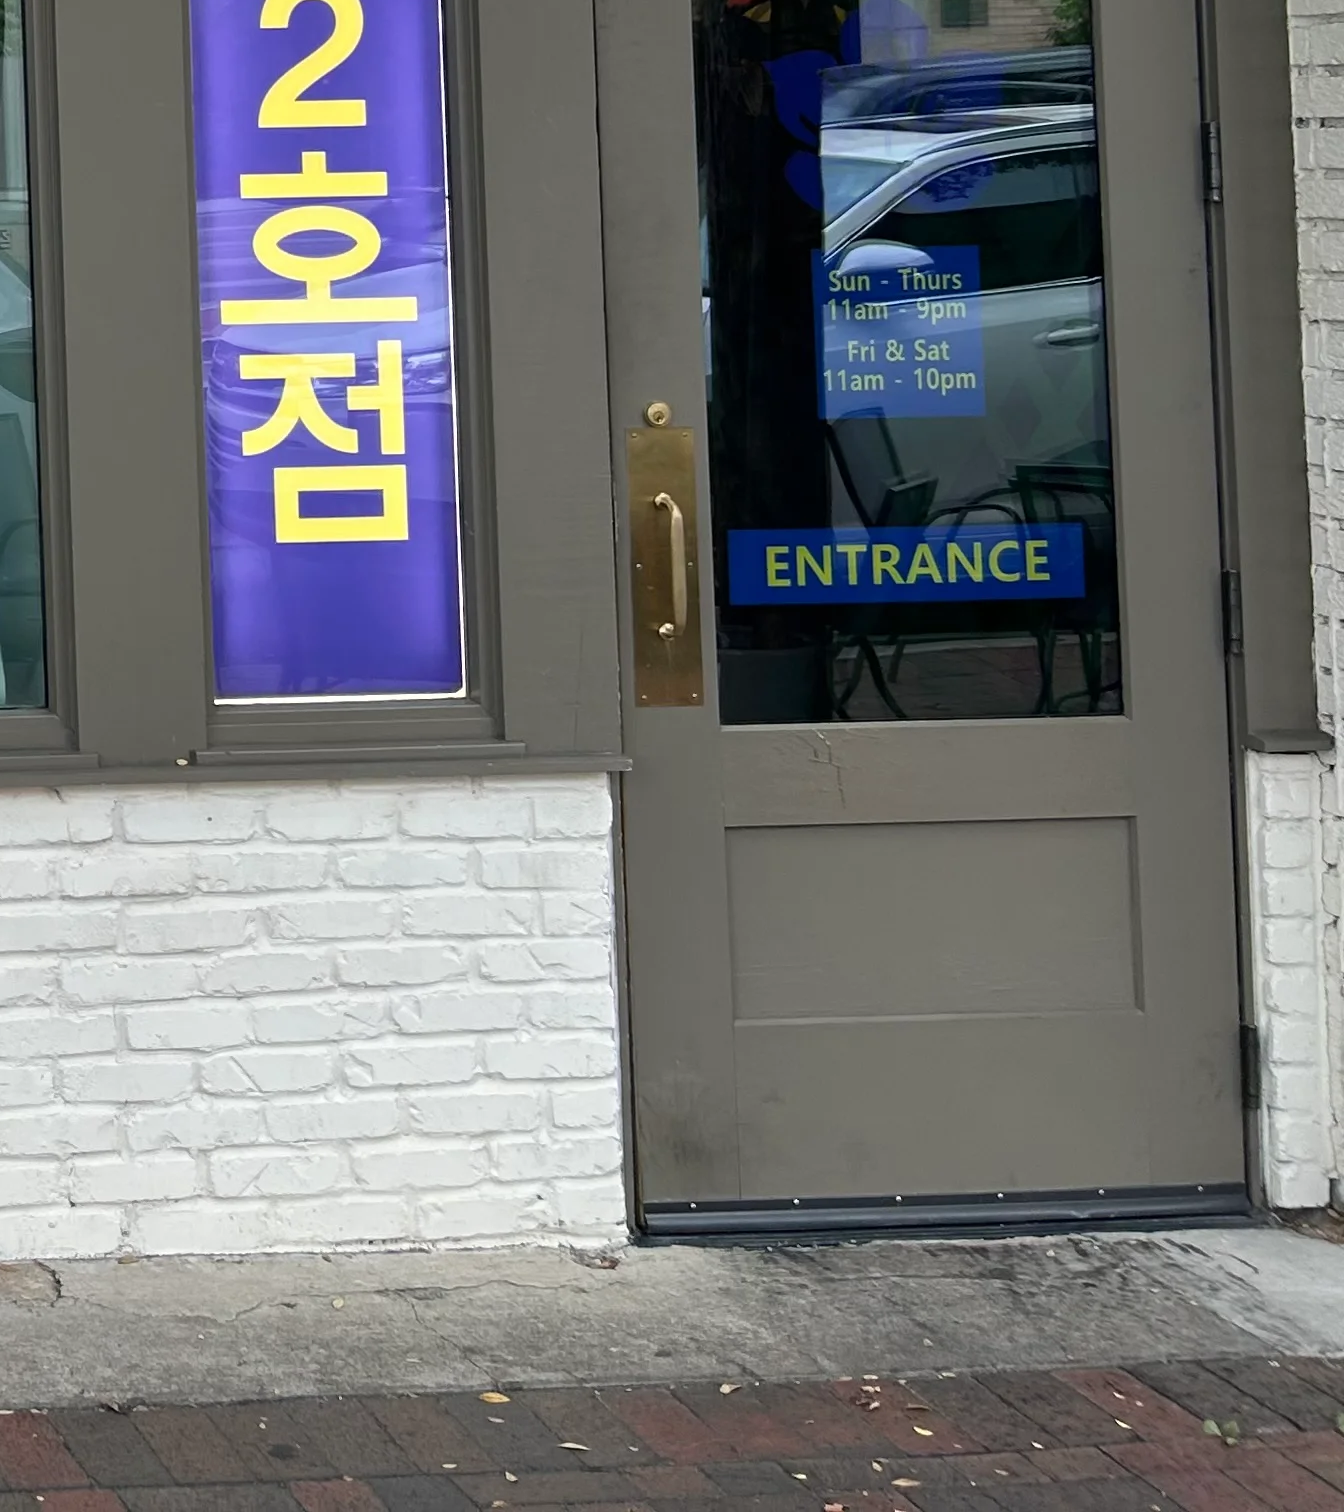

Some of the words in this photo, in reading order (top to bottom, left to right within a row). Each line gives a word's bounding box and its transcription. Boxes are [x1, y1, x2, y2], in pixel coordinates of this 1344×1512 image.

[828, 270, 871, 292] Sun
[897, 268, 962, 291] Thurs
[828, 298, 888, 320] 11am
[916, 298, 966, 325] 9pm
[847, 339, 876, 362] Fri
[885, 339, 906, 362] &
[914, 339, 950, 361] Sat
[823, 369, 884, 391] 11am
[913, 368, 976, 396] 10pm
[765, 539, 1051, 587] ENTRANCE
